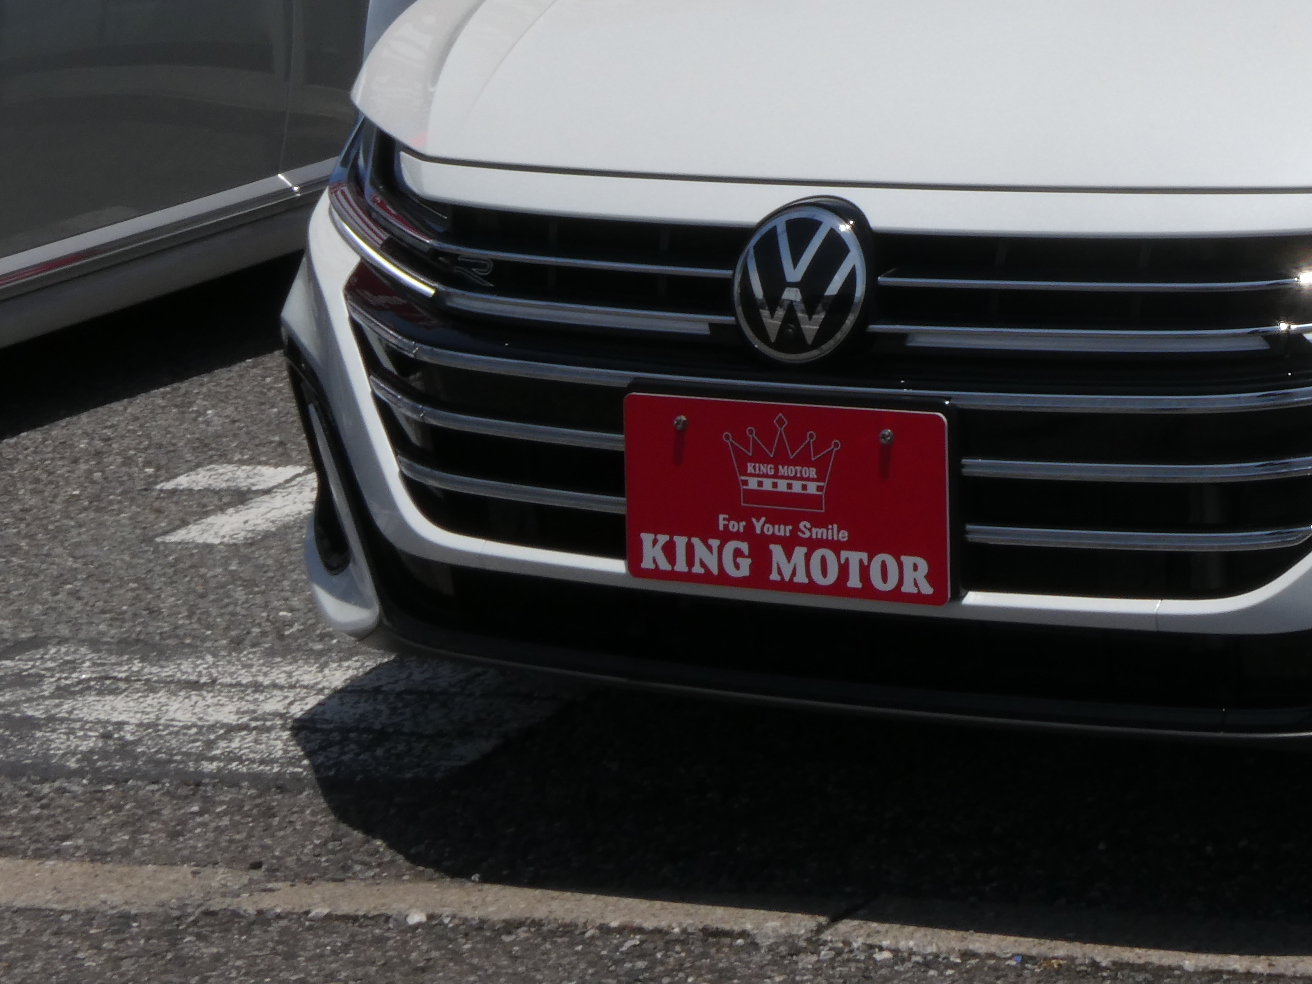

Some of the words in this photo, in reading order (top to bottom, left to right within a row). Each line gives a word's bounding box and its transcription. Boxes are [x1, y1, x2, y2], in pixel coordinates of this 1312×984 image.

[747, 462, 775, 476] KING
[778, 465, 817, 479] MOTOR
[718, 514, 746, 533] For
[751, 517, 792, 537] Your
[798, 521, 849, 542] Smile
[640, 533, 752, 578] KING
[768, 543, 934, 595] MOTOR
